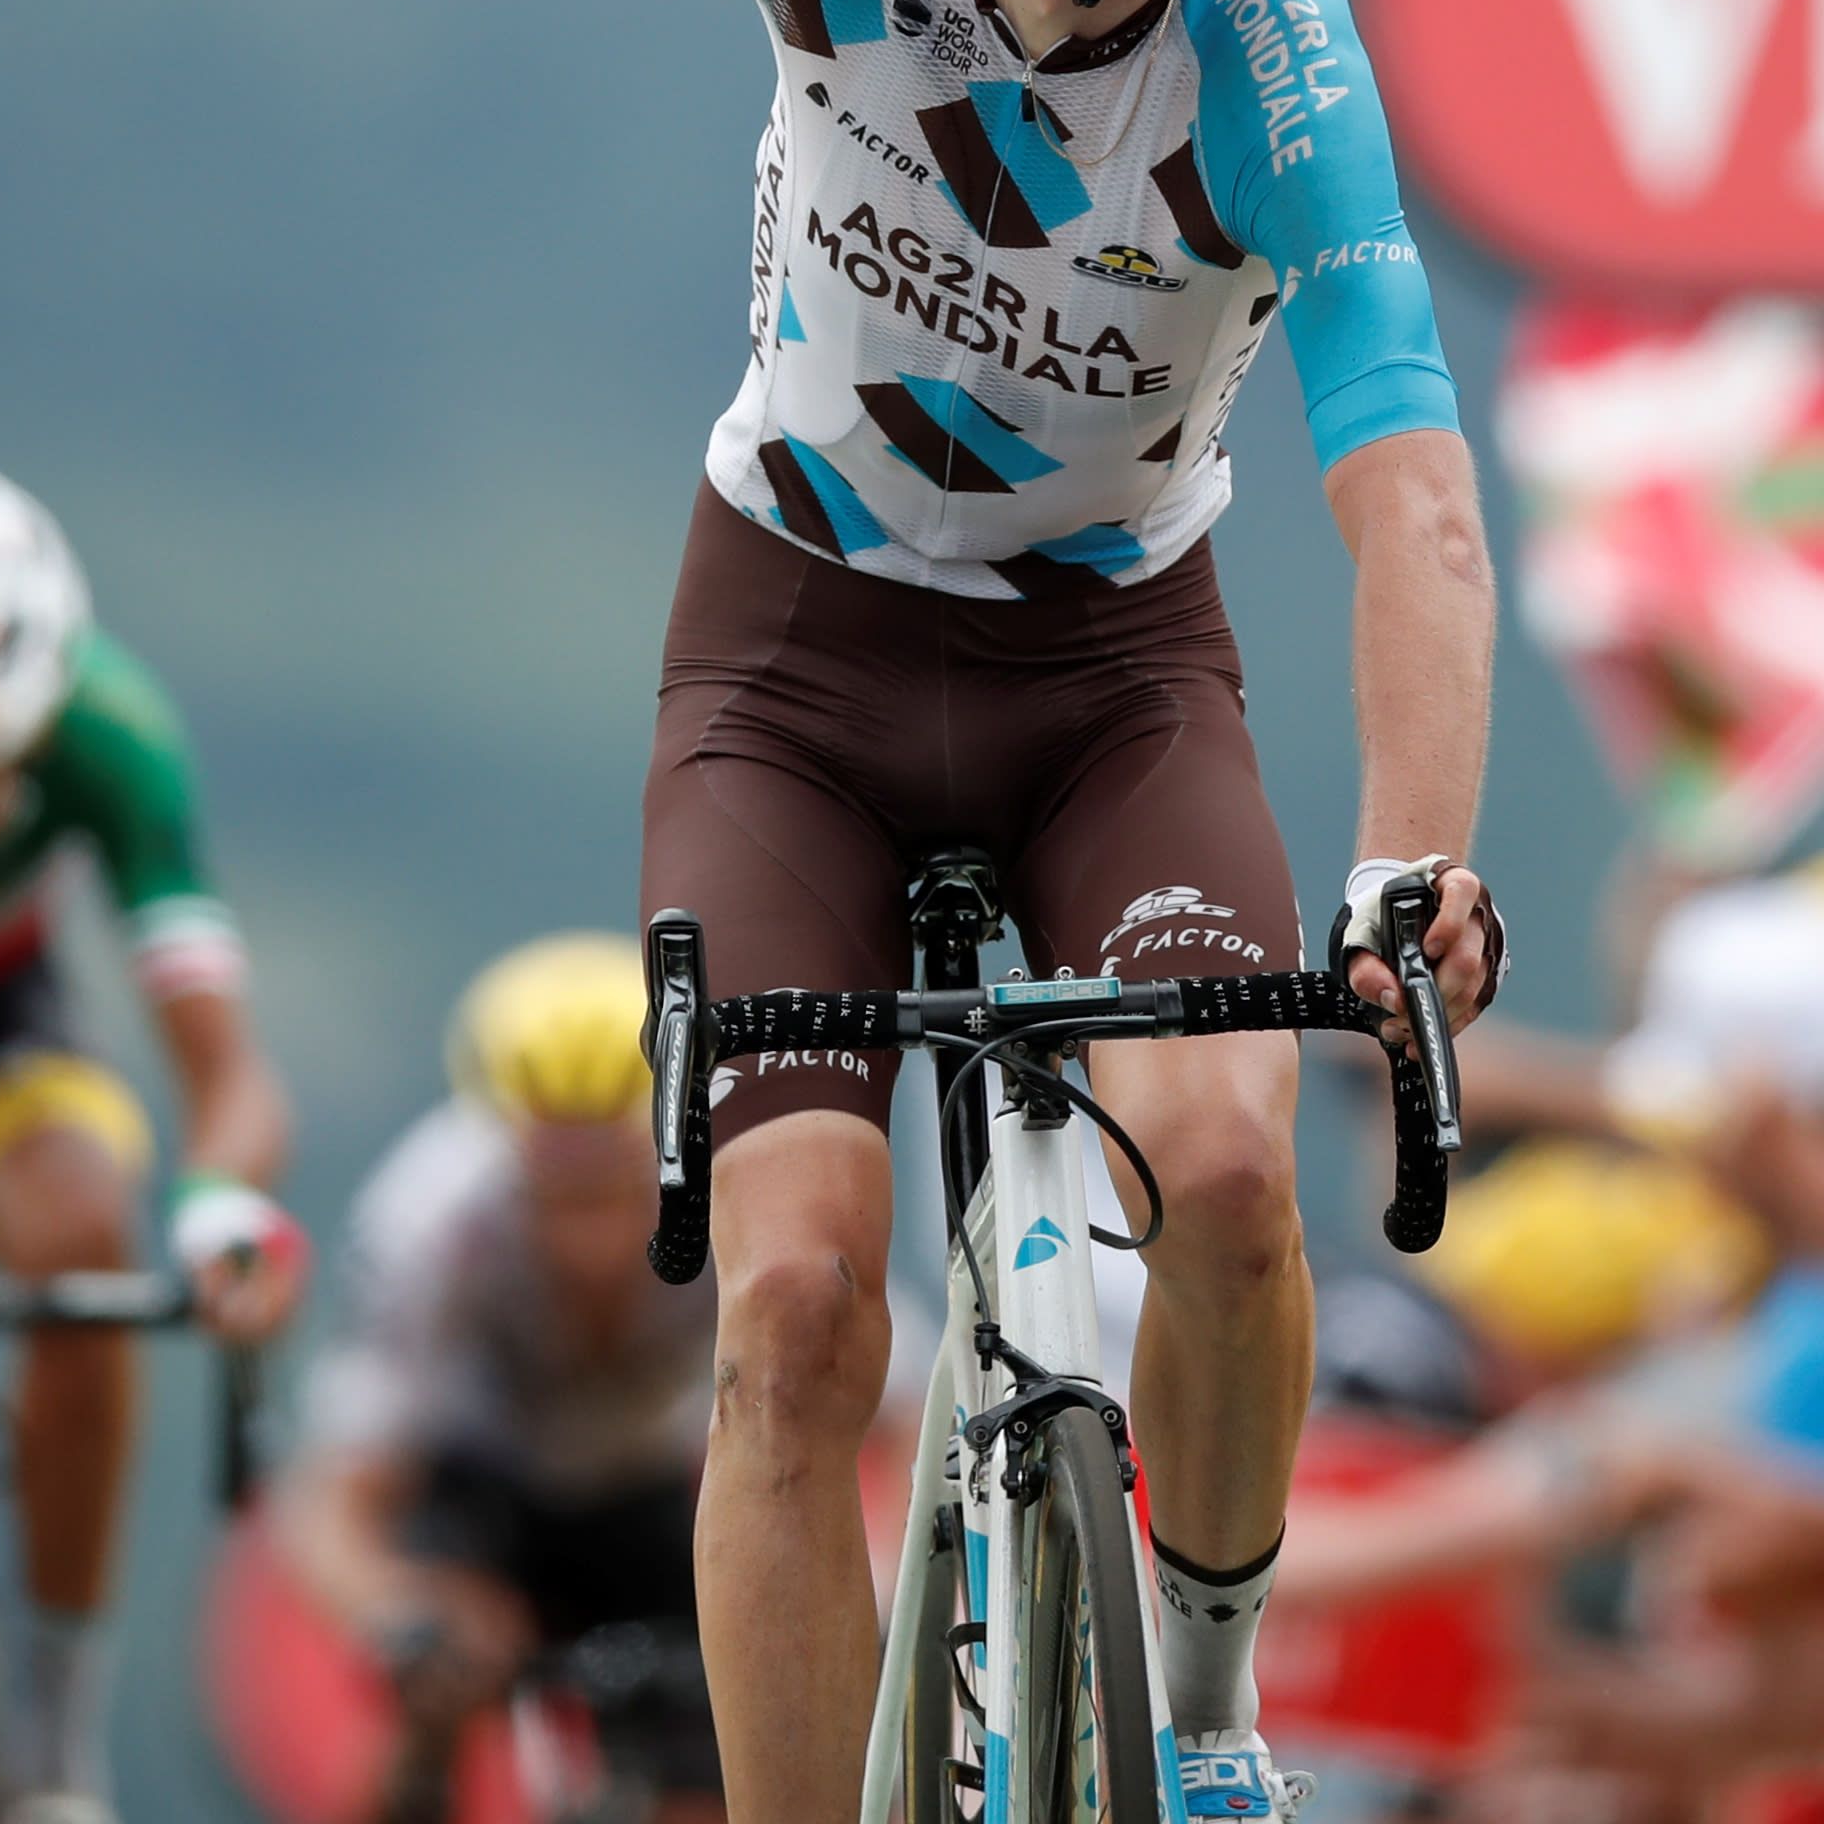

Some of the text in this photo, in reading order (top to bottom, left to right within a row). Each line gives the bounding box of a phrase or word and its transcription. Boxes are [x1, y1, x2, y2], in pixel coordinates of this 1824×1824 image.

[944, 8, 976, 37] UCI
[931, 40, 972, 75] TOUR
[936, 26, 989, 67] WORLD
[1302, 57, 1350, 113] LA
[837, 110, 930, 185] FACTOR
[1314, 241, 1417, 277] FACTOR
[840, 201, 1140, 363] AG2R LA
[807, 207, 1172, 398] MONDIALE
[1132, 928, 1265, 964] FACTOR
[758, 1049, 870, 1082] FACTOR
